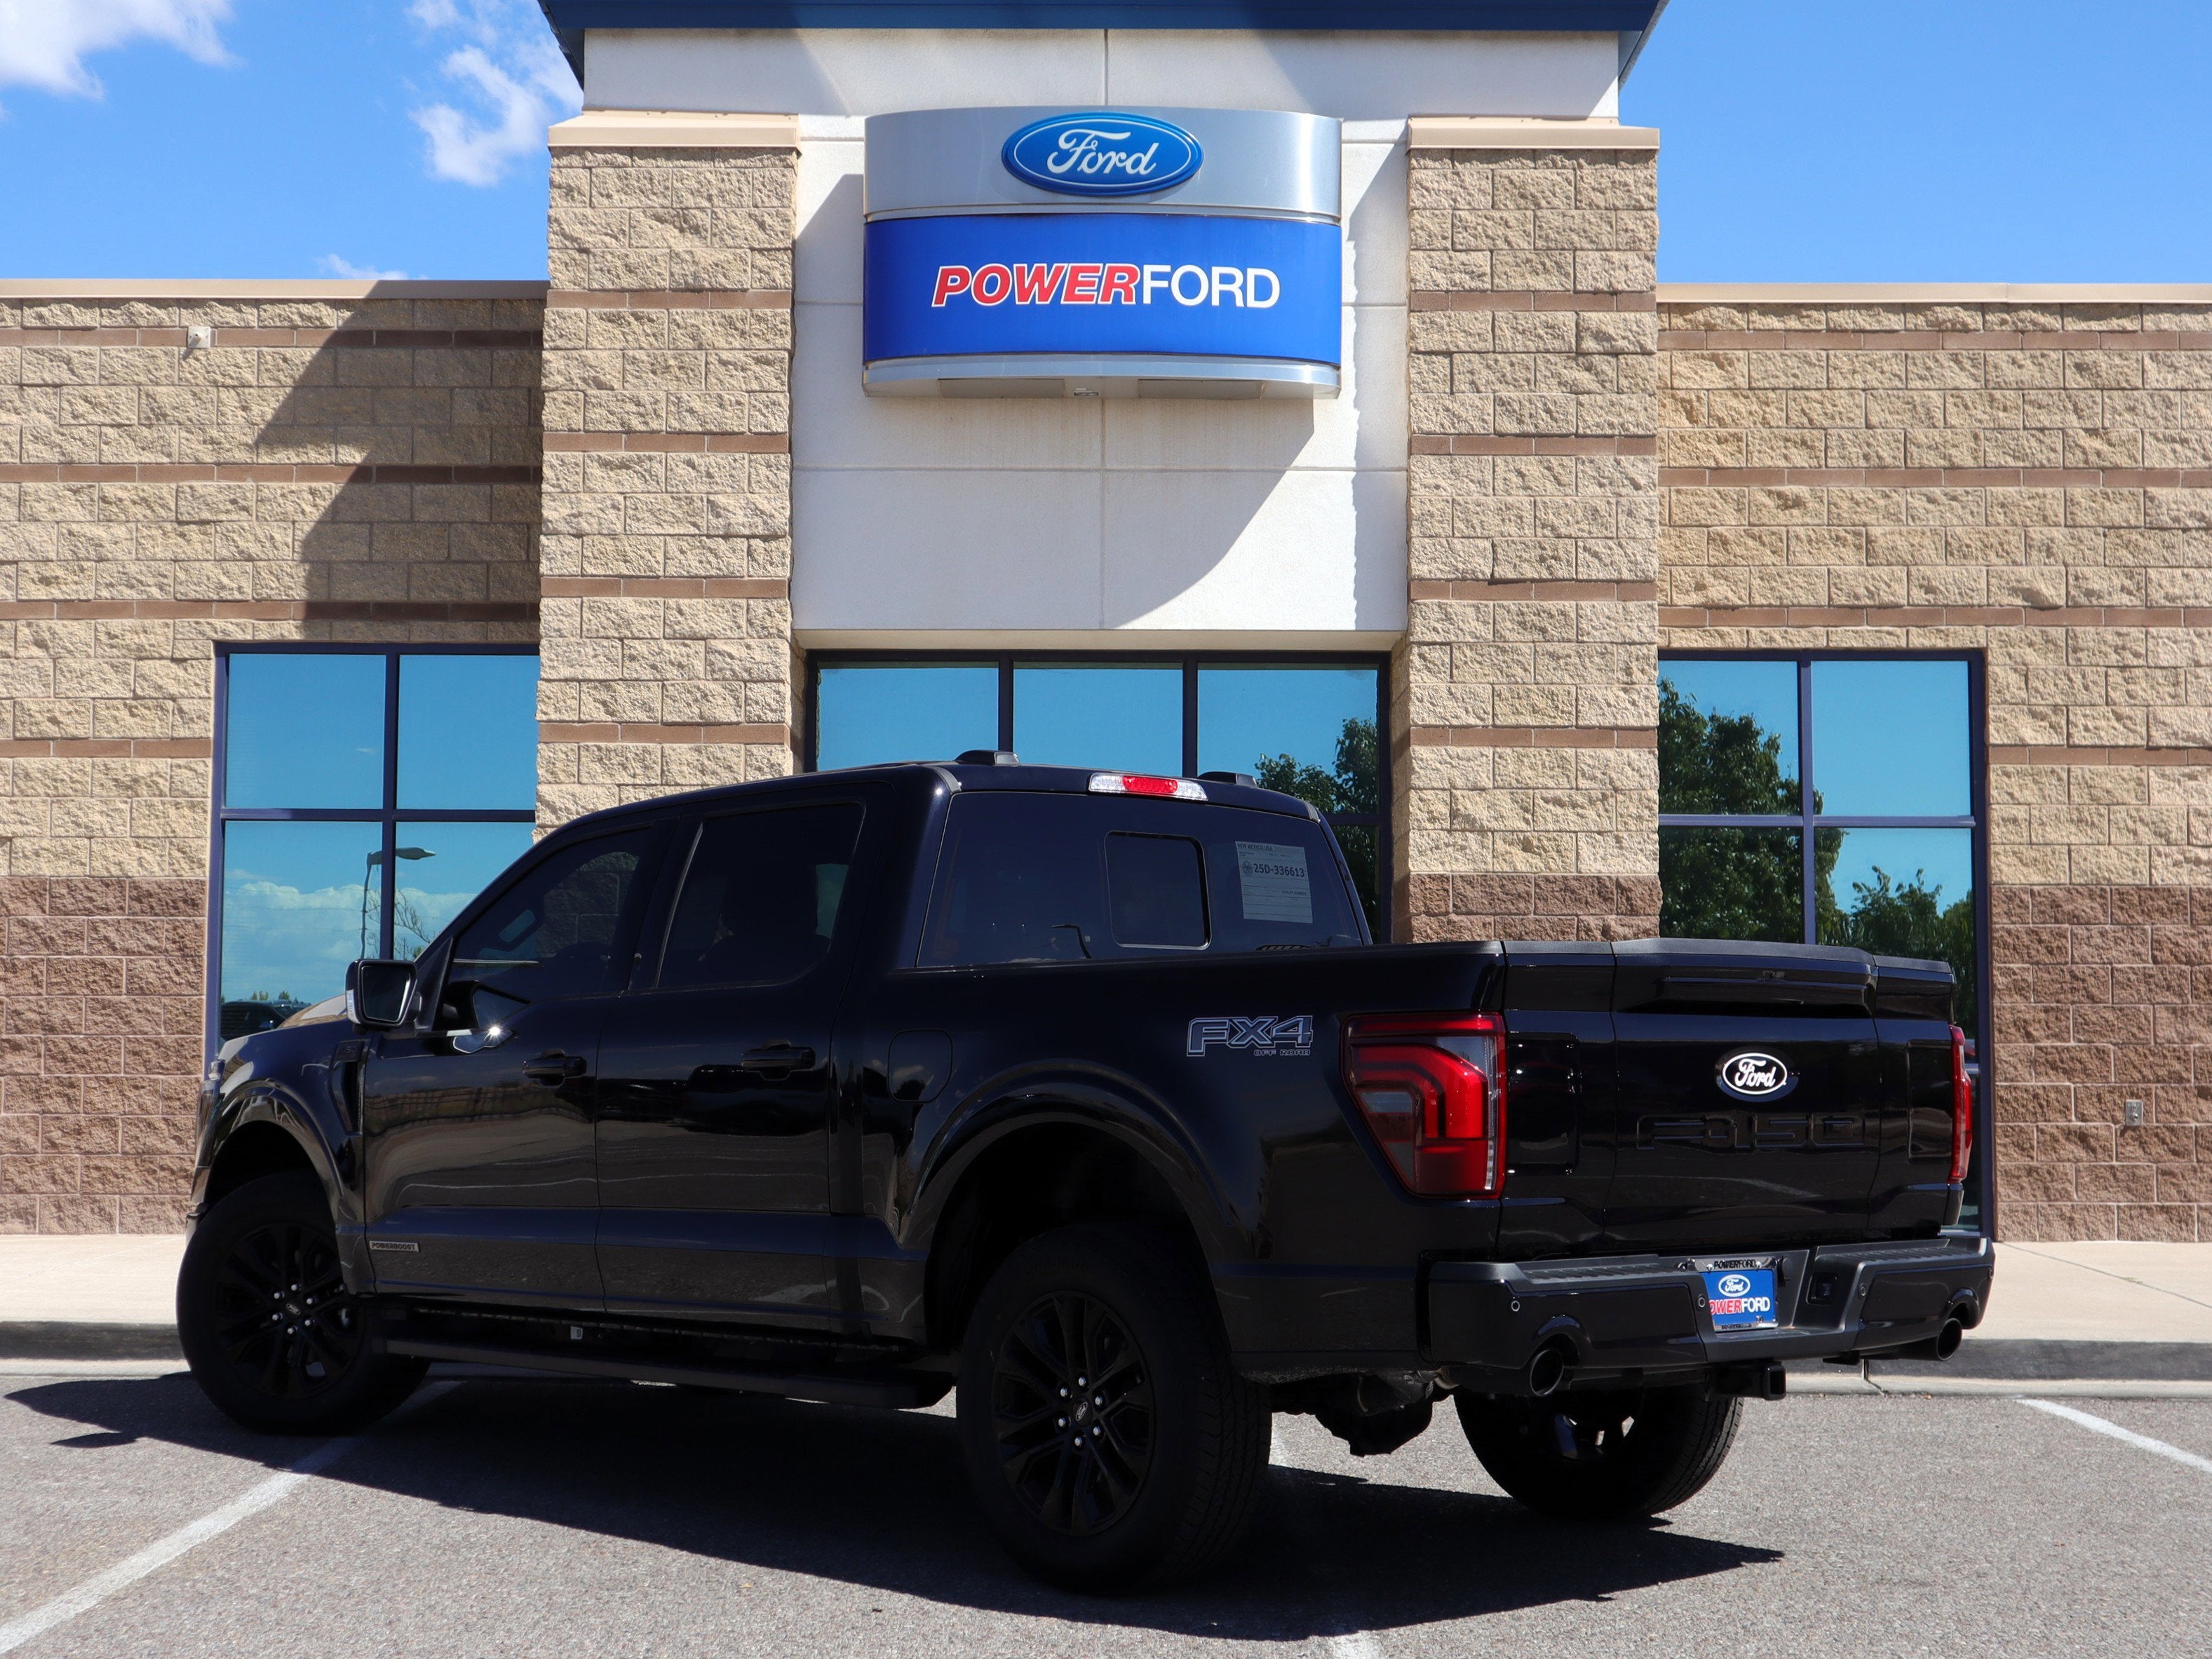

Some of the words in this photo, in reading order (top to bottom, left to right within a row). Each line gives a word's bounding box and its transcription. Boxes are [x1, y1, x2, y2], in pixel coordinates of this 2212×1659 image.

[1046, 128, 1159, 175] Ford
[931, 262, 1281, 309] POWERFORD
[1253, 863, 1305, 877] 25D-336613
[1187, 1015, 1314, 1057] FX4
[1734, 1058, 1776, 1087] Ford
[371, 1242, 415, 1251] POWERBOOST
[1714, 1259, 1757, 1268] POWERFORD
[1725, 1278, 1744, 1292] Ford
[1709, 1296, 1771, 1315] OWERFORD
